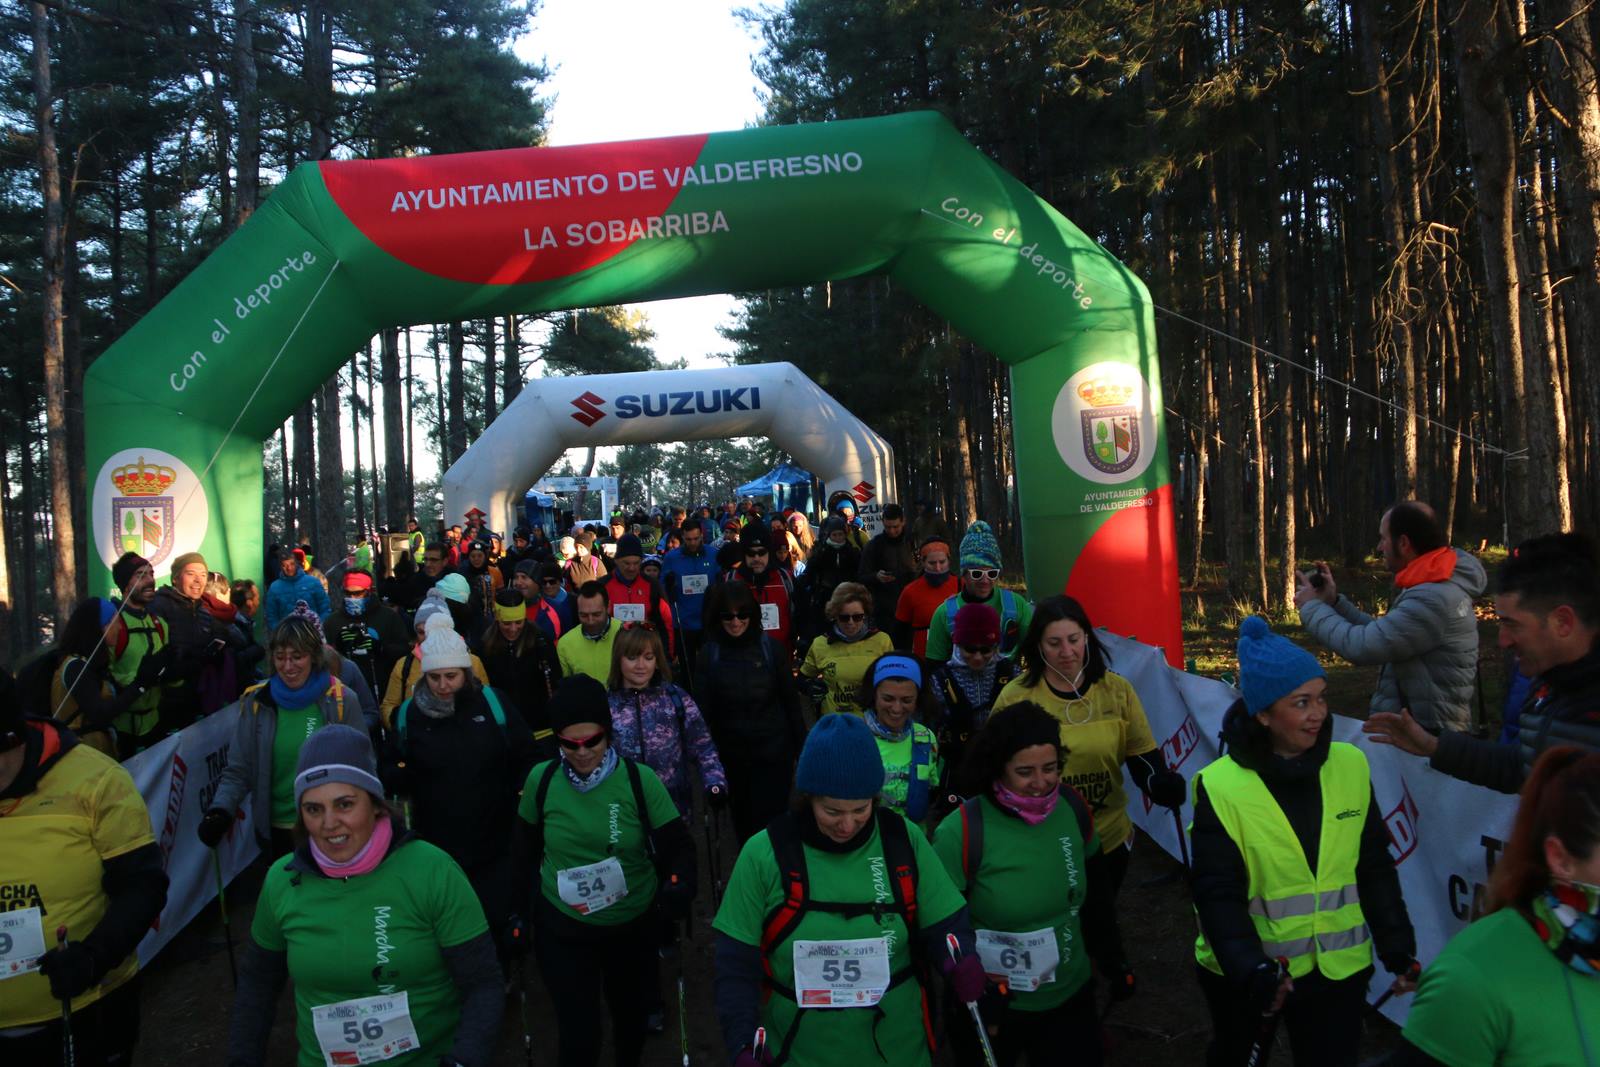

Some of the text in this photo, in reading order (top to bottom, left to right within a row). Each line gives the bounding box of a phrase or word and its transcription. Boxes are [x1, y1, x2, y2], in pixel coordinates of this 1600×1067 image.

[391, 152, 863, 212] AYUNTAMIENTO DE VALDEFRESNO
[523, 210, 730, 251] LA SOBARRIBA
[941, 197, 1092, 309] Con el deporte
[170, 251, 316, 391] Con el deporte
[615, 387, 760, 419] SUZUKI
[1080, 498, 1154, 513] DE VALDEFRESNO
[1084, 487, 1149, 501] AYUNTAMIENTO
[623, 610, 635, 618] 71
[1062, 770, 1110, 785] MARCHA
[577, 877, 606, 898] 54
[373, 905, 396, 965] Marcha
[822, 959, 862, 982] 55
[1001, 949, 1032, 970] 61
[343, 1018, 384, 1044] 56
